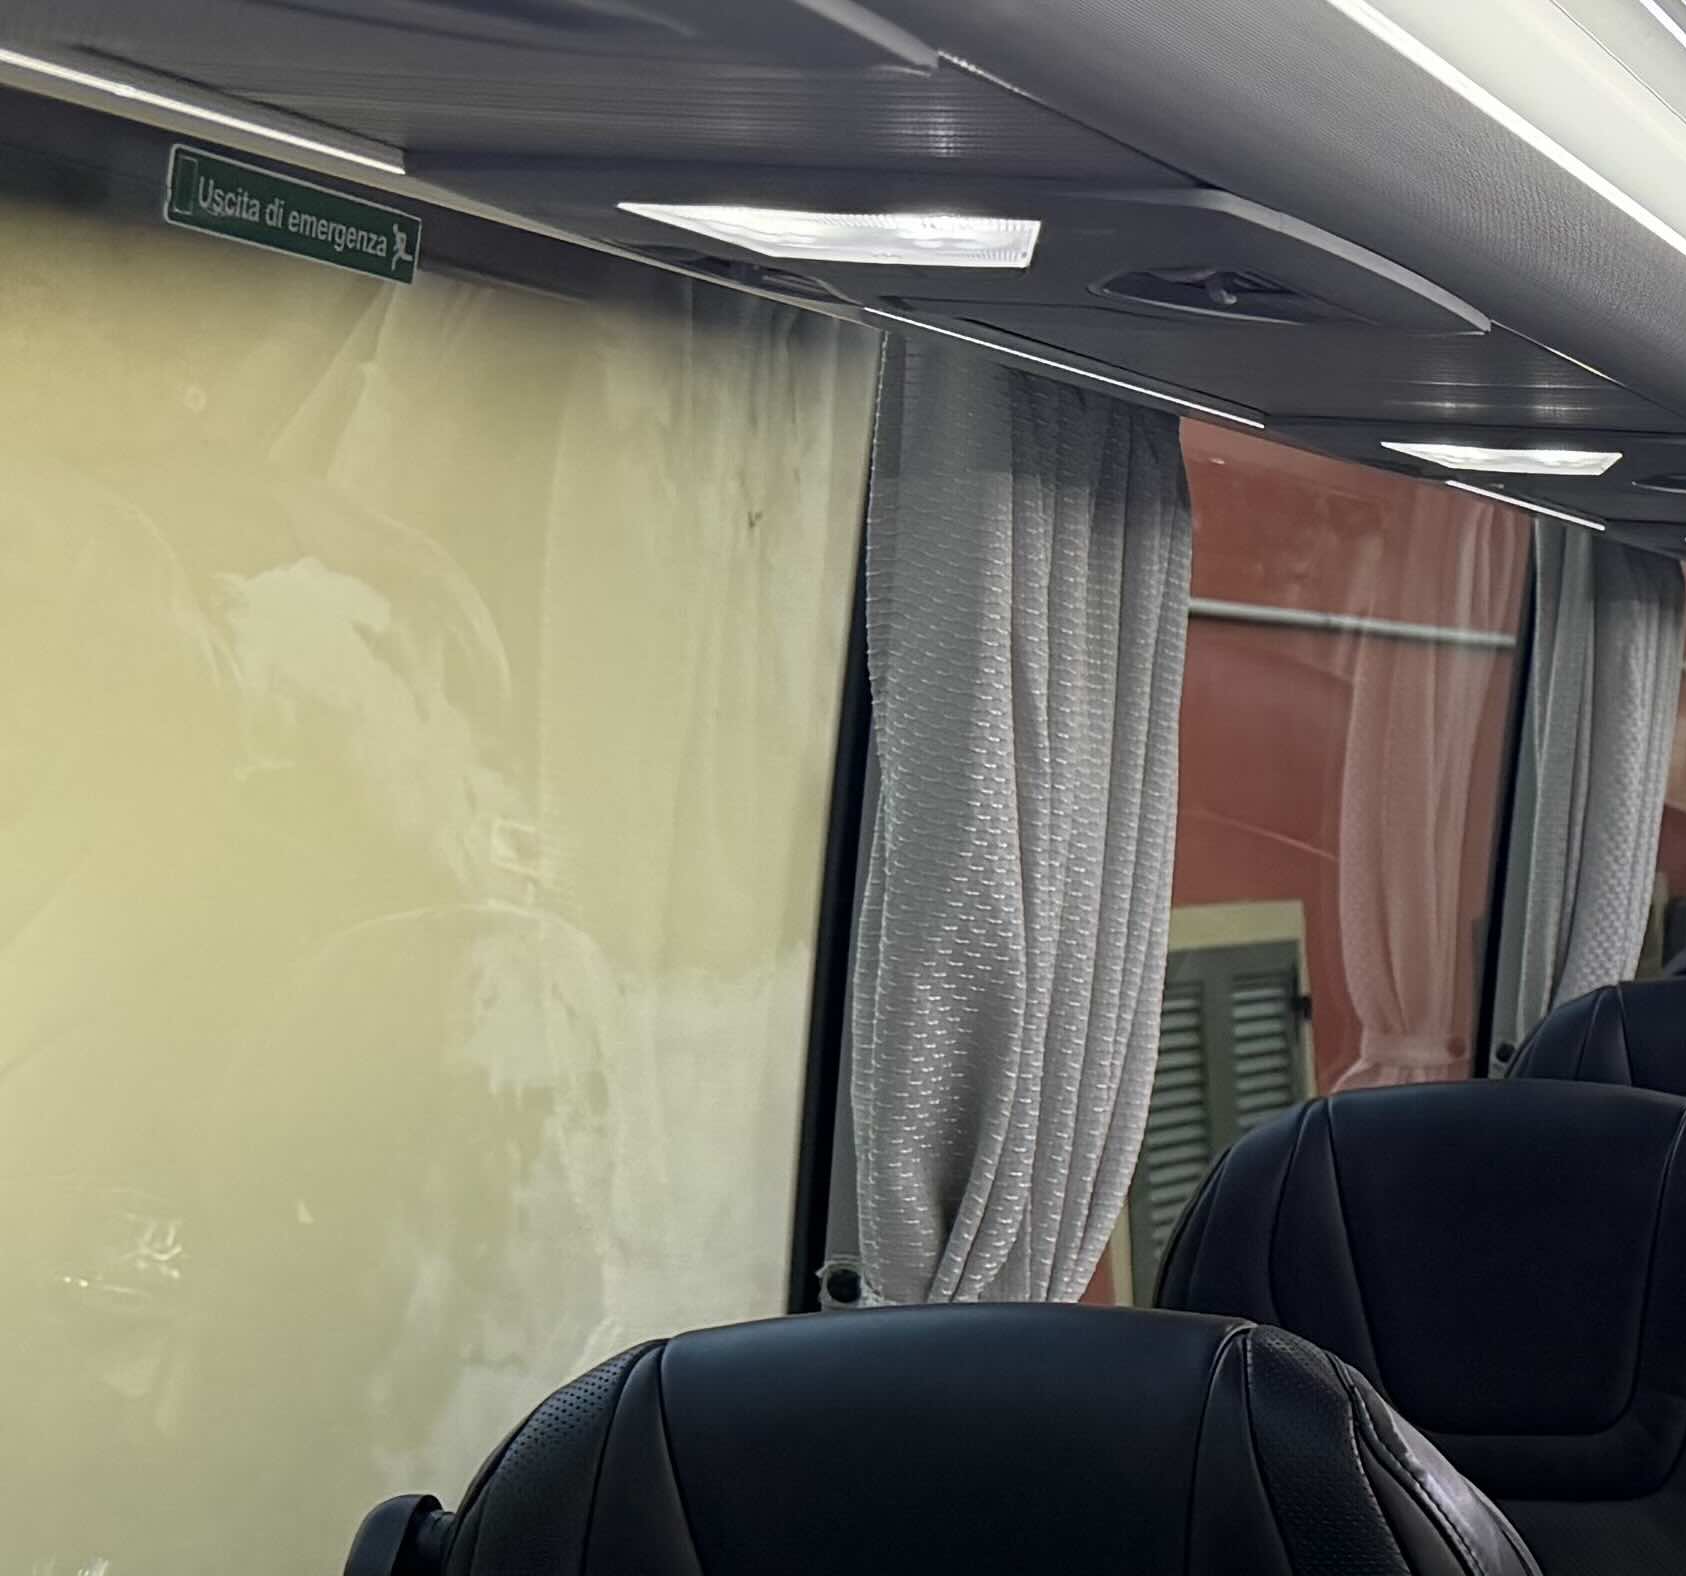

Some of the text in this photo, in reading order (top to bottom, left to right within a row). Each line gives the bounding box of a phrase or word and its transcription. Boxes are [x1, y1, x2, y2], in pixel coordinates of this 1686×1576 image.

[198, 176, 387, 257] Uscita di emergenza
